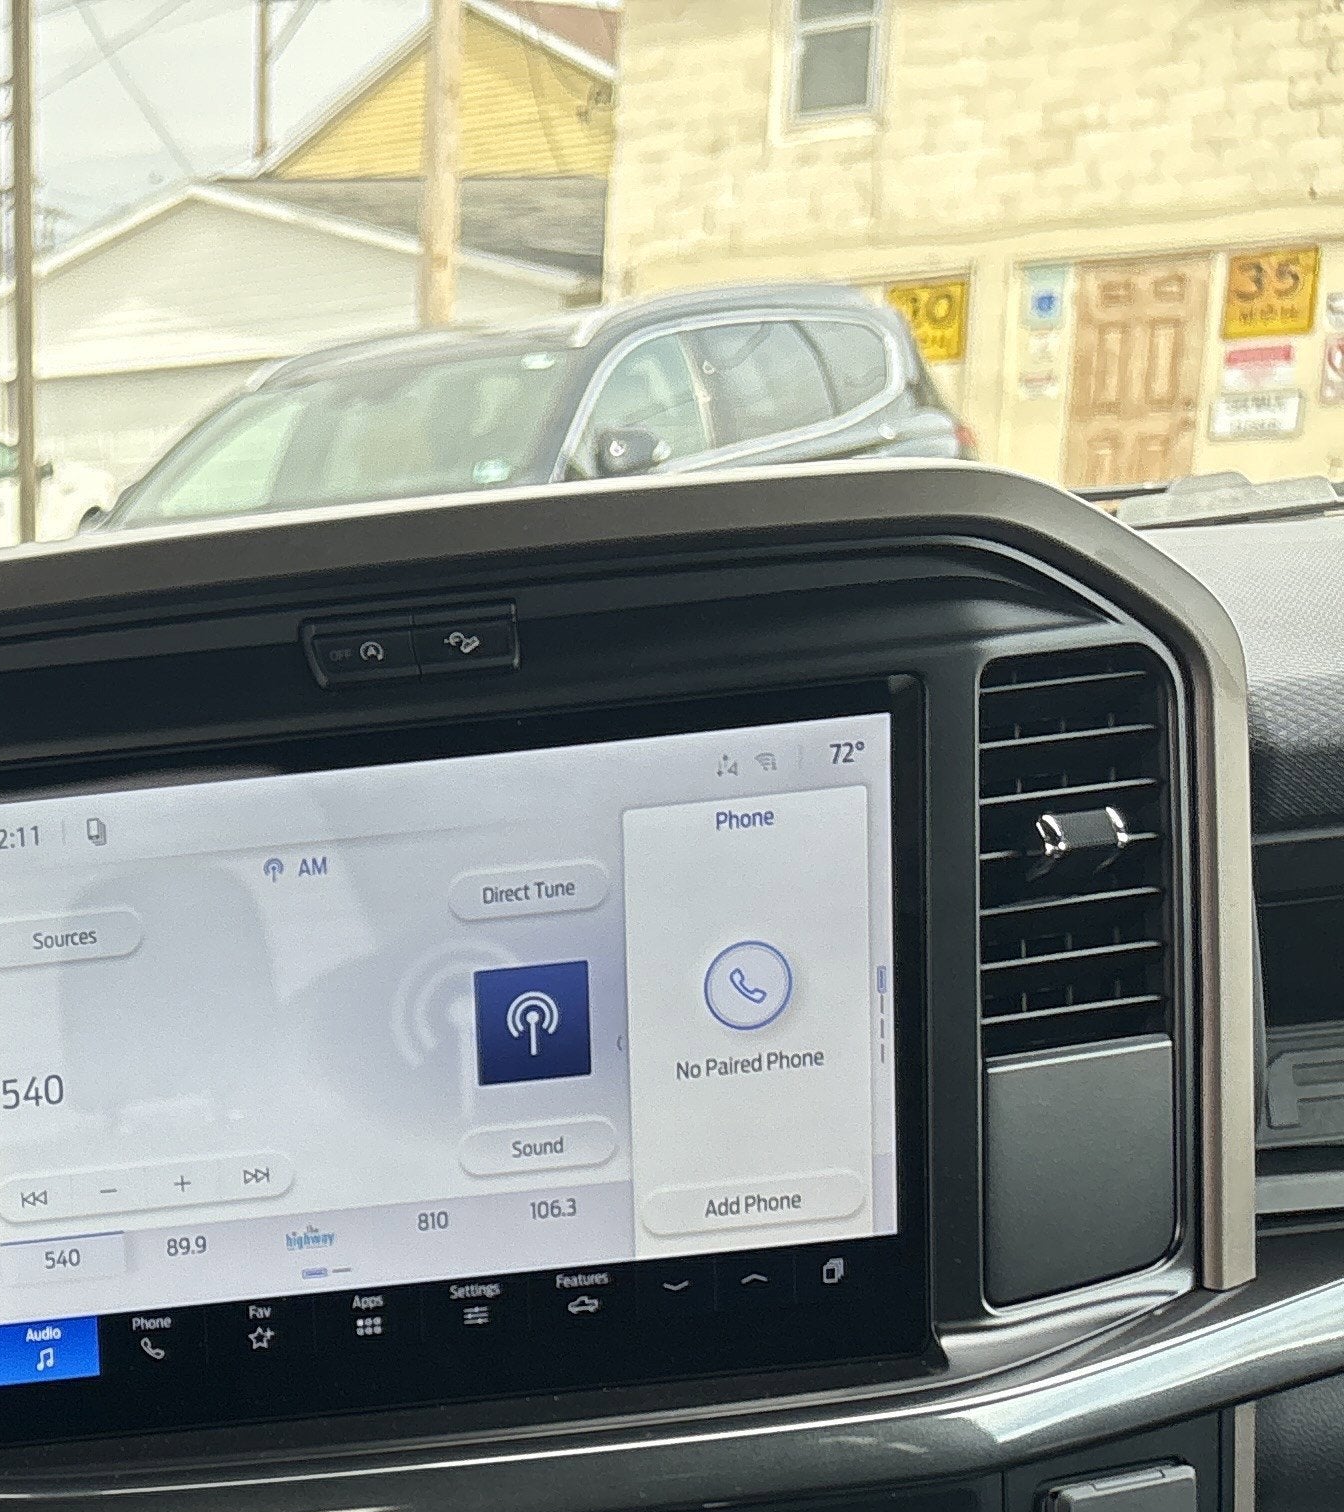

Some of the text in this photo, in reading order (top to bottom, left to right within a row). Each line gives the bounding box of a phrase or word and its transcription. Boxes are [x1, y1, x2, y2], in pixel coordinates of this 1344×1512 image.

[830, 741, 865, 764] 72°
[715, 809, 775, 831] Phone
[298, 856, 328, 876] AM
[482, 879, 575, 904] Direct Tune
[32, 930, 97, 950] Sources
[676, 1050, 825, 1080] No Paired Phone
[2, 1074, 64, 1109] 540
[512, 1137, 564, 1158] Sound
[529, 1199, 577, 1221] 106.3
[704, 1192, 802, 1218] Add Phone
[417, 1211, 449, 1232] 810
[166, 1235, 207, 1257] 89.9
[44, 1249, 80, 1269] 540
[449, 1281, 500, 1300] Settings
[555, 1271, 609, 1289] Features
[248, 1305, 272, 1320] Fav
[352, 1295, 384, 1311] Apps
[25, 1326, 61, 1342] Audio
[132, 1316, 172, 1331] Phone
